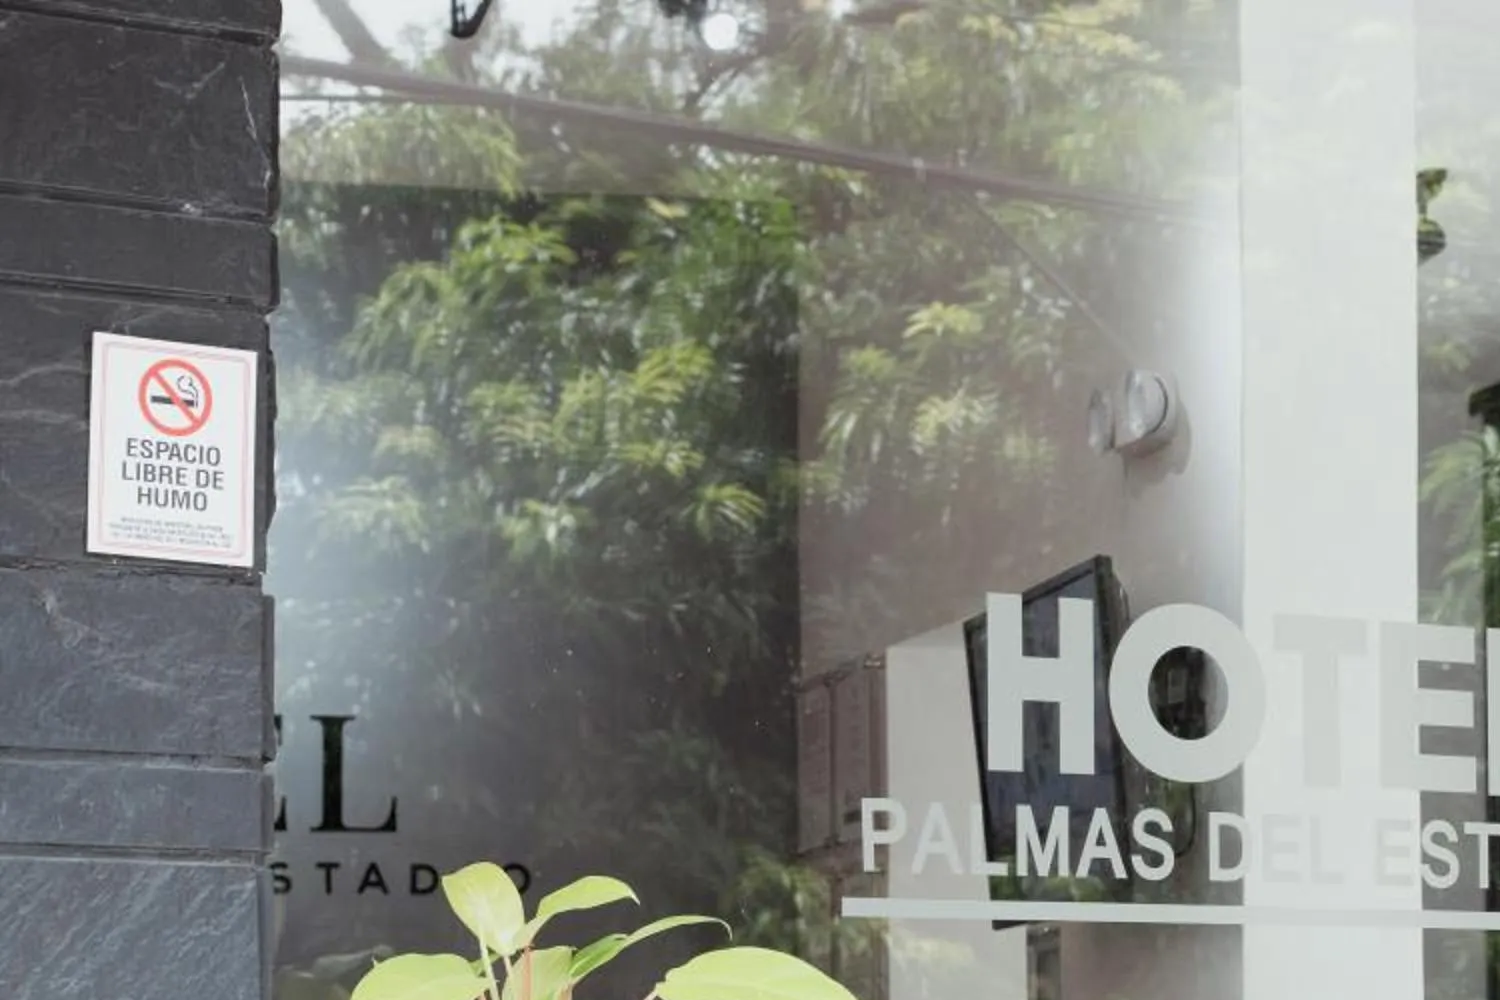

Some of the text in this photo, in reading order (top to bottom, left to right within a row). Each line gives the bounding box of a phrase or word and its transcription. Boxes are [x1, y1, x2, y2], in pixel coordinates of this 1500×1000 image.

[127, 438, 221, 467] ESPACIO
[121, 460, 225, 491] LIBRE DE
[136, 486, 208, 512] HUMO
[274, 713, 398, 832] L
[860, 797, 1176, 880] PALMAS
[1208, 810, 1344, 884] DEL
